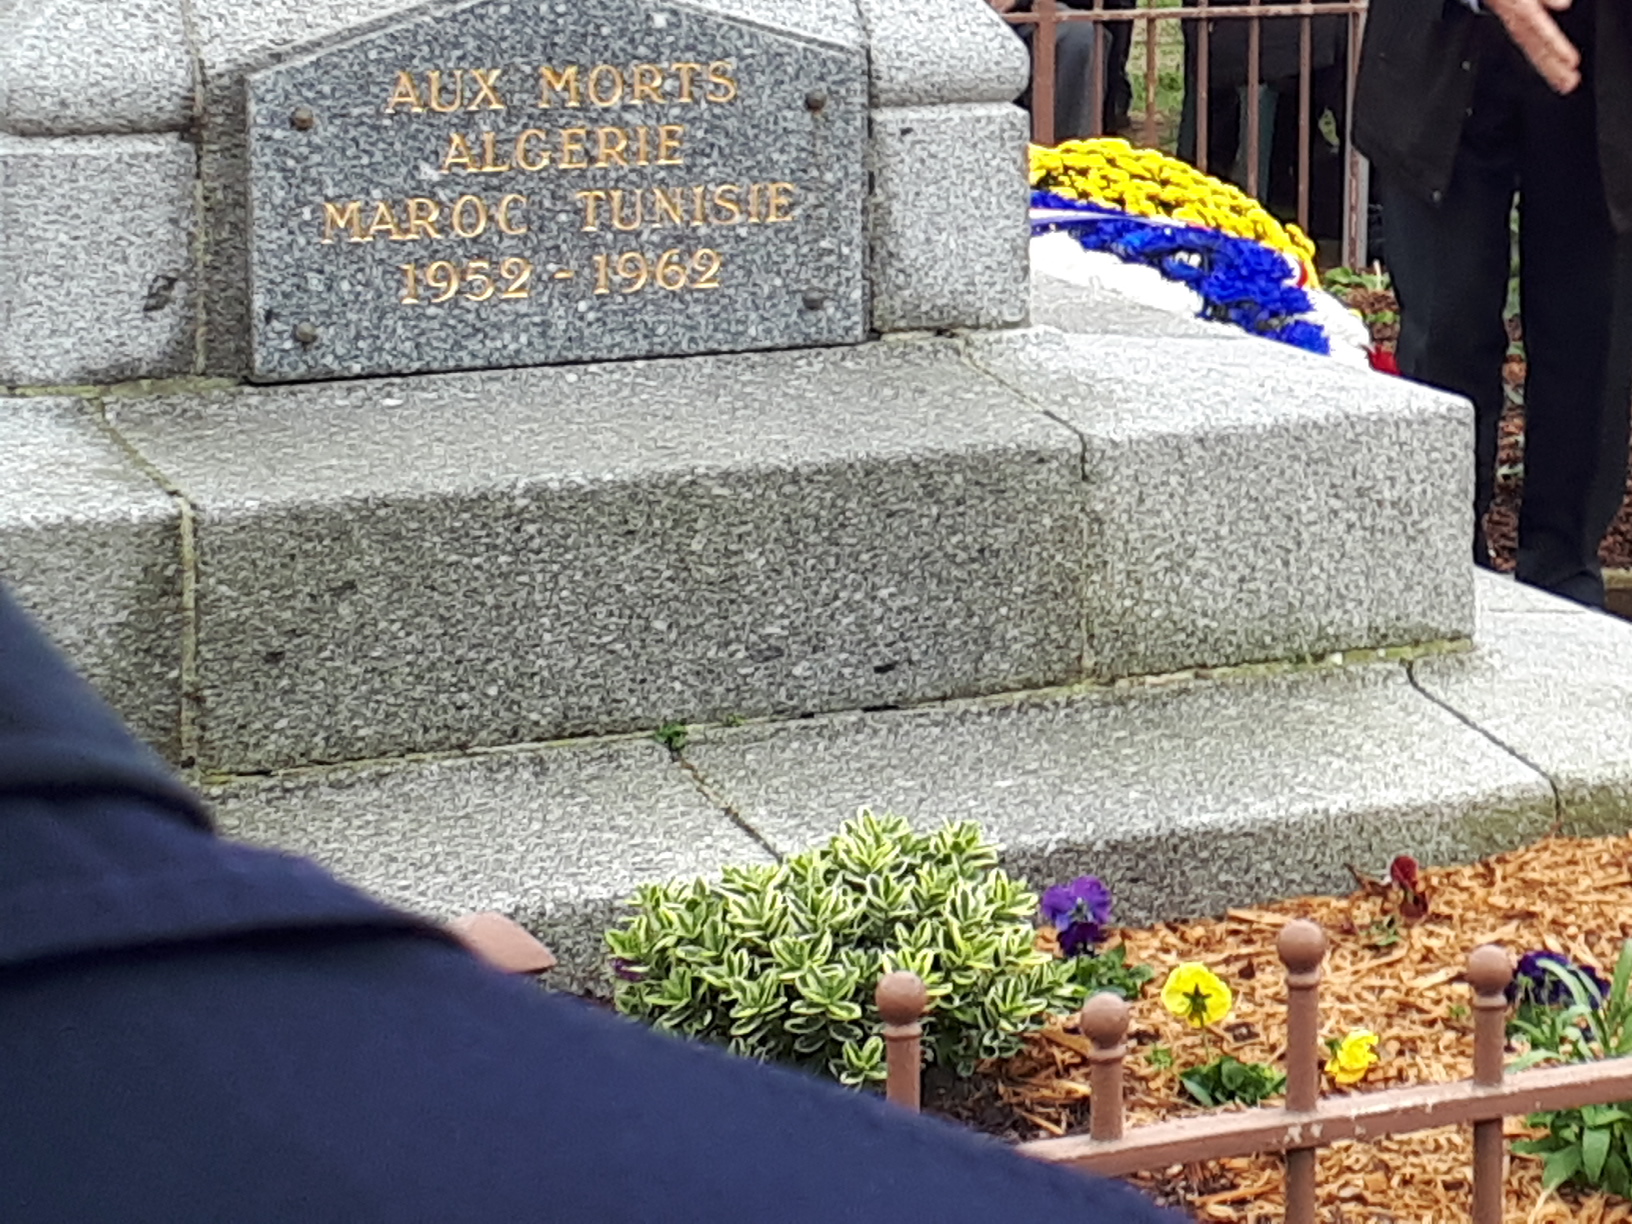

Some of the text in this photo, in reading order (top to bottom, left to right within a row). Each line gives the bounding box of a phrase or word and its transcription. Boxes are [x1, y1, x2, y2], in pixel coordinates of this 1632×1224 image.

[385, 61, 738, 114] AUX MORTS
[321, 181, 796, 244] MAROC TUNISIE
[401, 257, 532, 304] 1952
[592, 248, 722, 295] 1962
